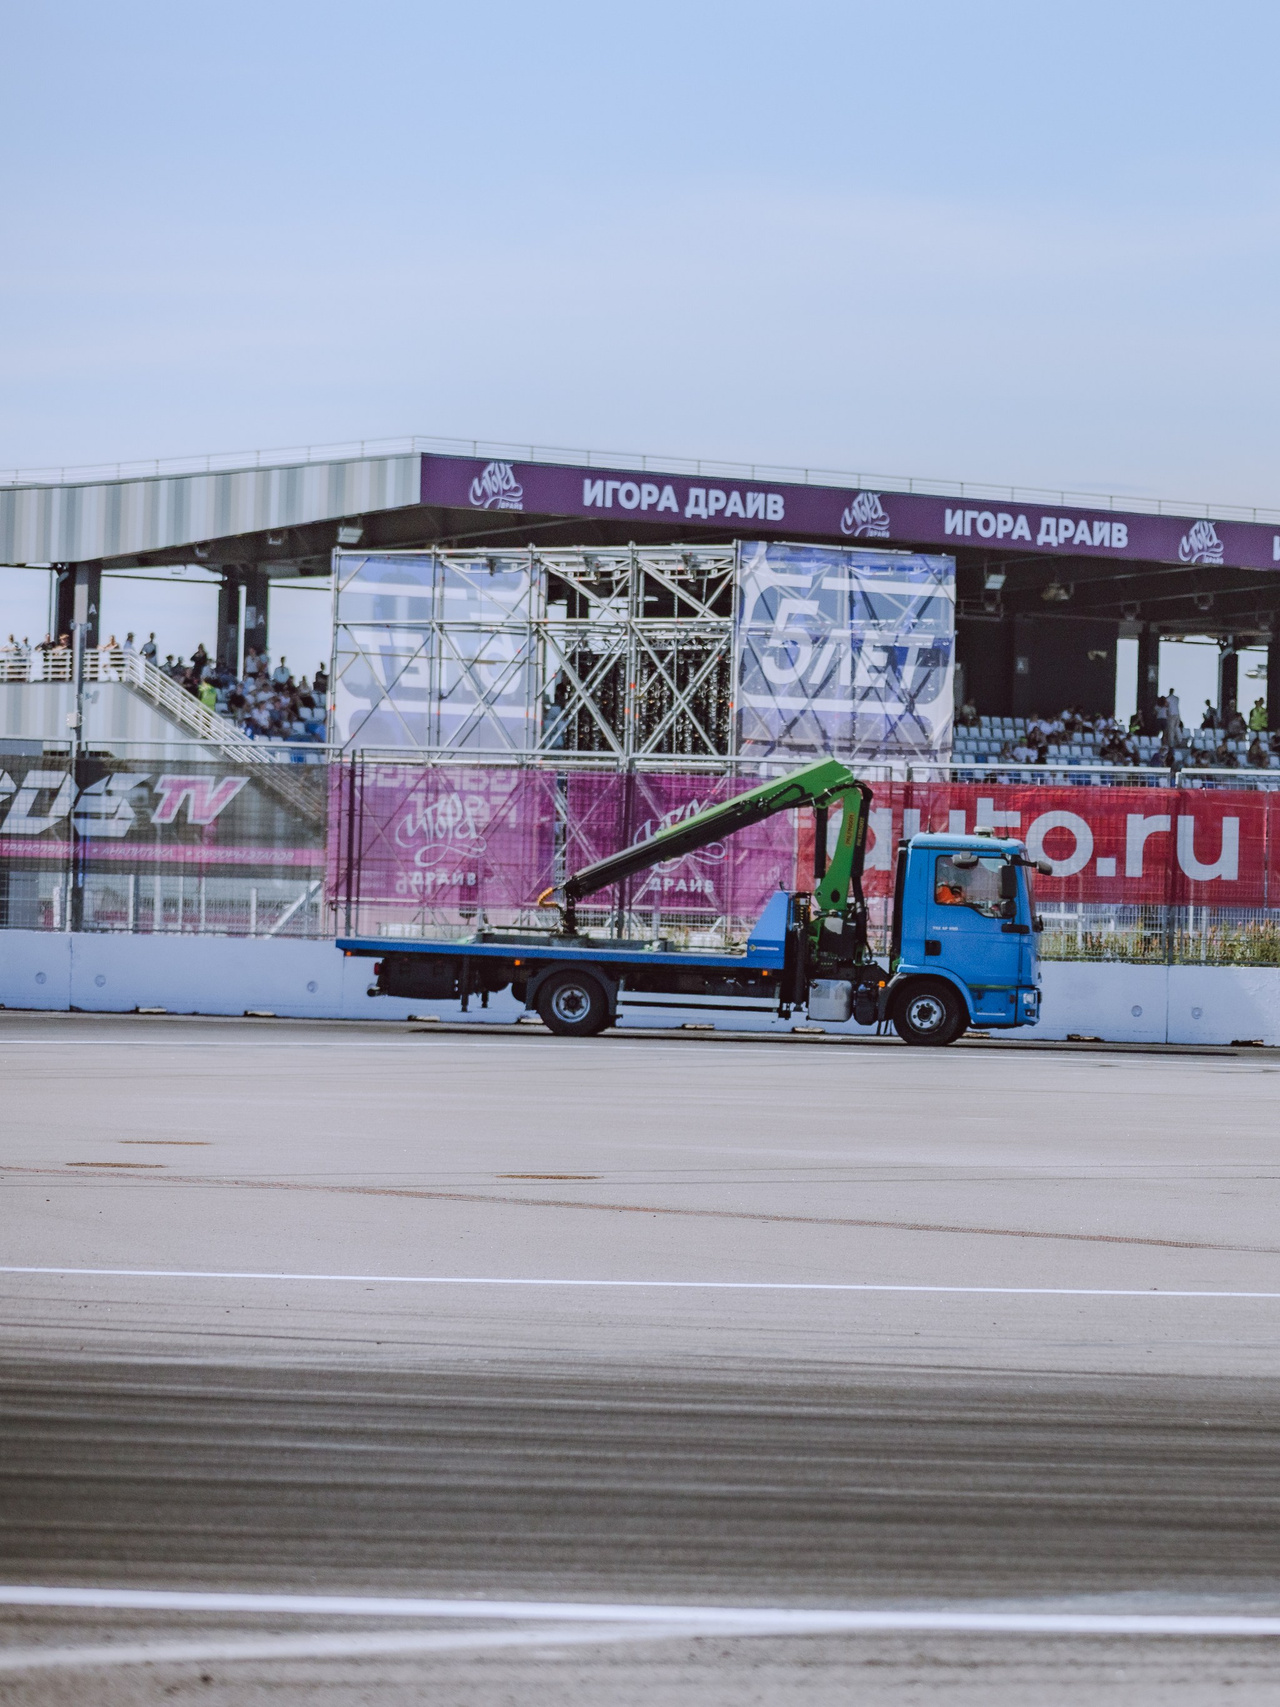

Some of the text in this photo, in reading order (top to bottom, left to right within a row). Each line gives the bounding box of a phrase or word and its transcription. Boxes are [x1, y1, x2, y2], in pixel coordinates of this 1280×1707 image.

[582, 478, 785, 521] ИГОРА ДРАЙВ
[944, 508, 1129, 549] ИГОРА ДРАЙВ
[0, 769, 251, 838] DS TV
[648, 877, 715, 893] ДРАЙВ
